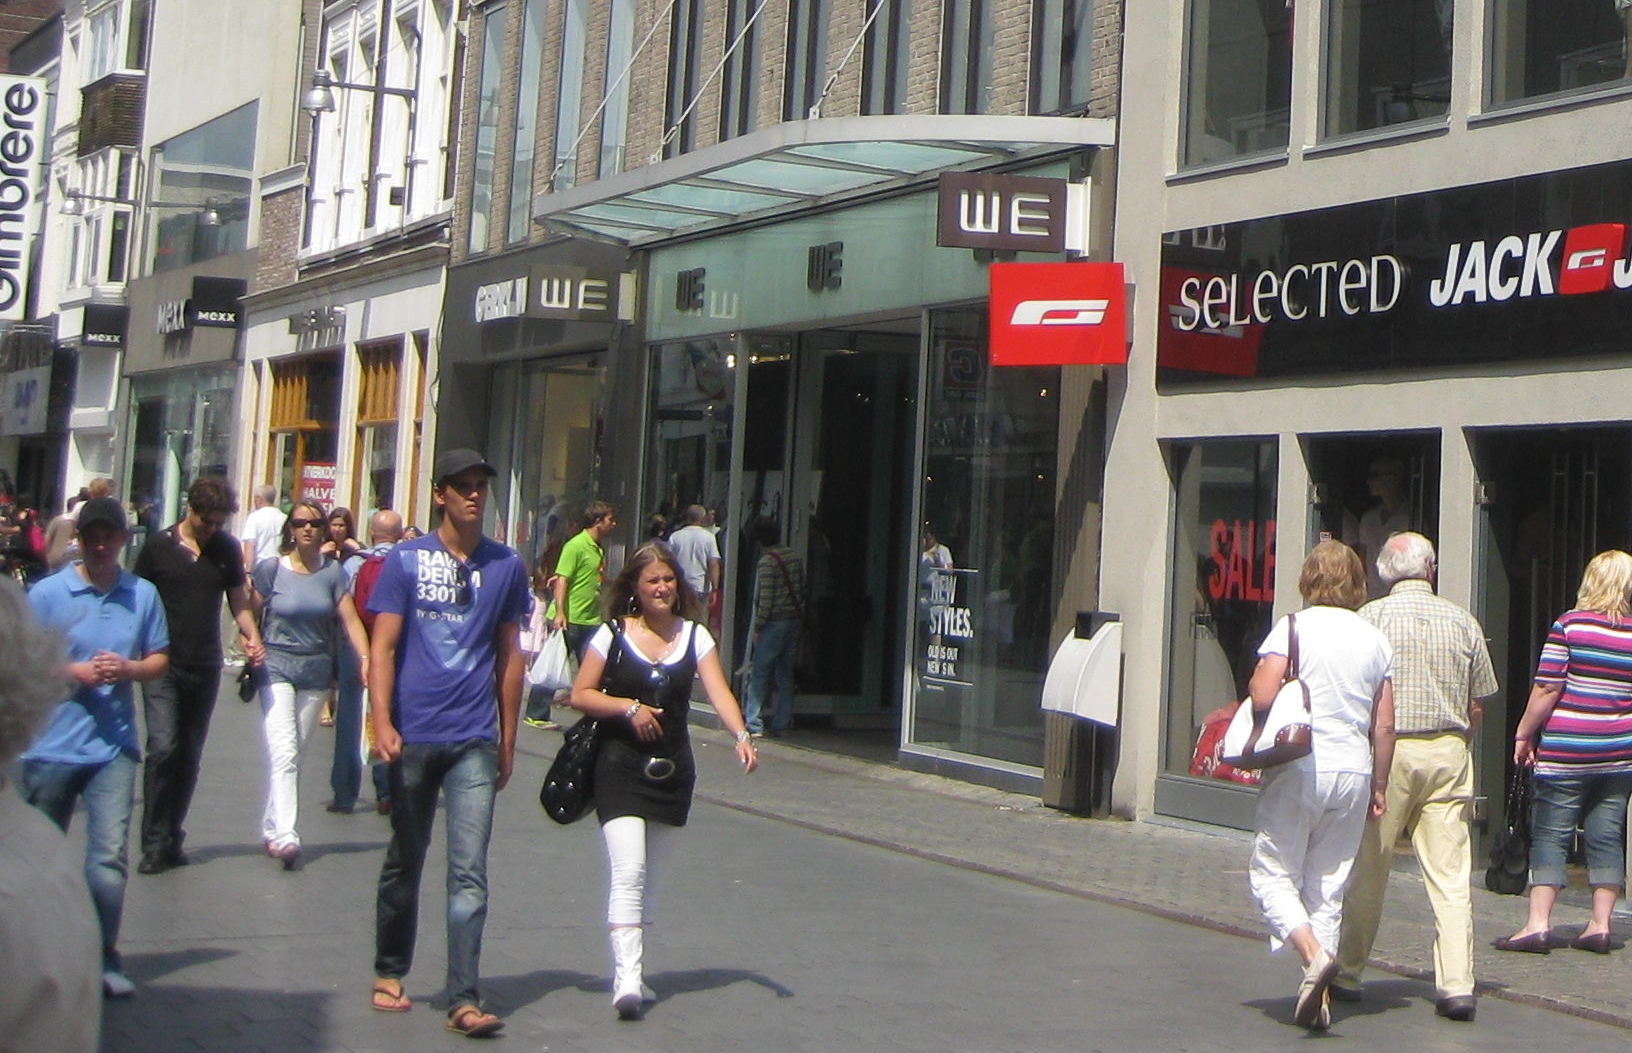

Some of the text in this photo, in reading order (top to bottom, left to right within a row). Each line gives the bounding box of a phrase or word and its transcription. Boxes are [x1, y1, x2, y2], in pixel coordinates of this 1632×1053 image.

[960, 190, 1050, 236] WE
[676, 267, 705, 310] WE
[807, 241, 843, 292] WE
[1430, 230, 1564, 307] JACK
[541, 278, 608, 311] WE
[417, 564, 481, 588] DENM
[1208, 519, 1277, 602] SALE
[416, 583, 456, 604] 3301
